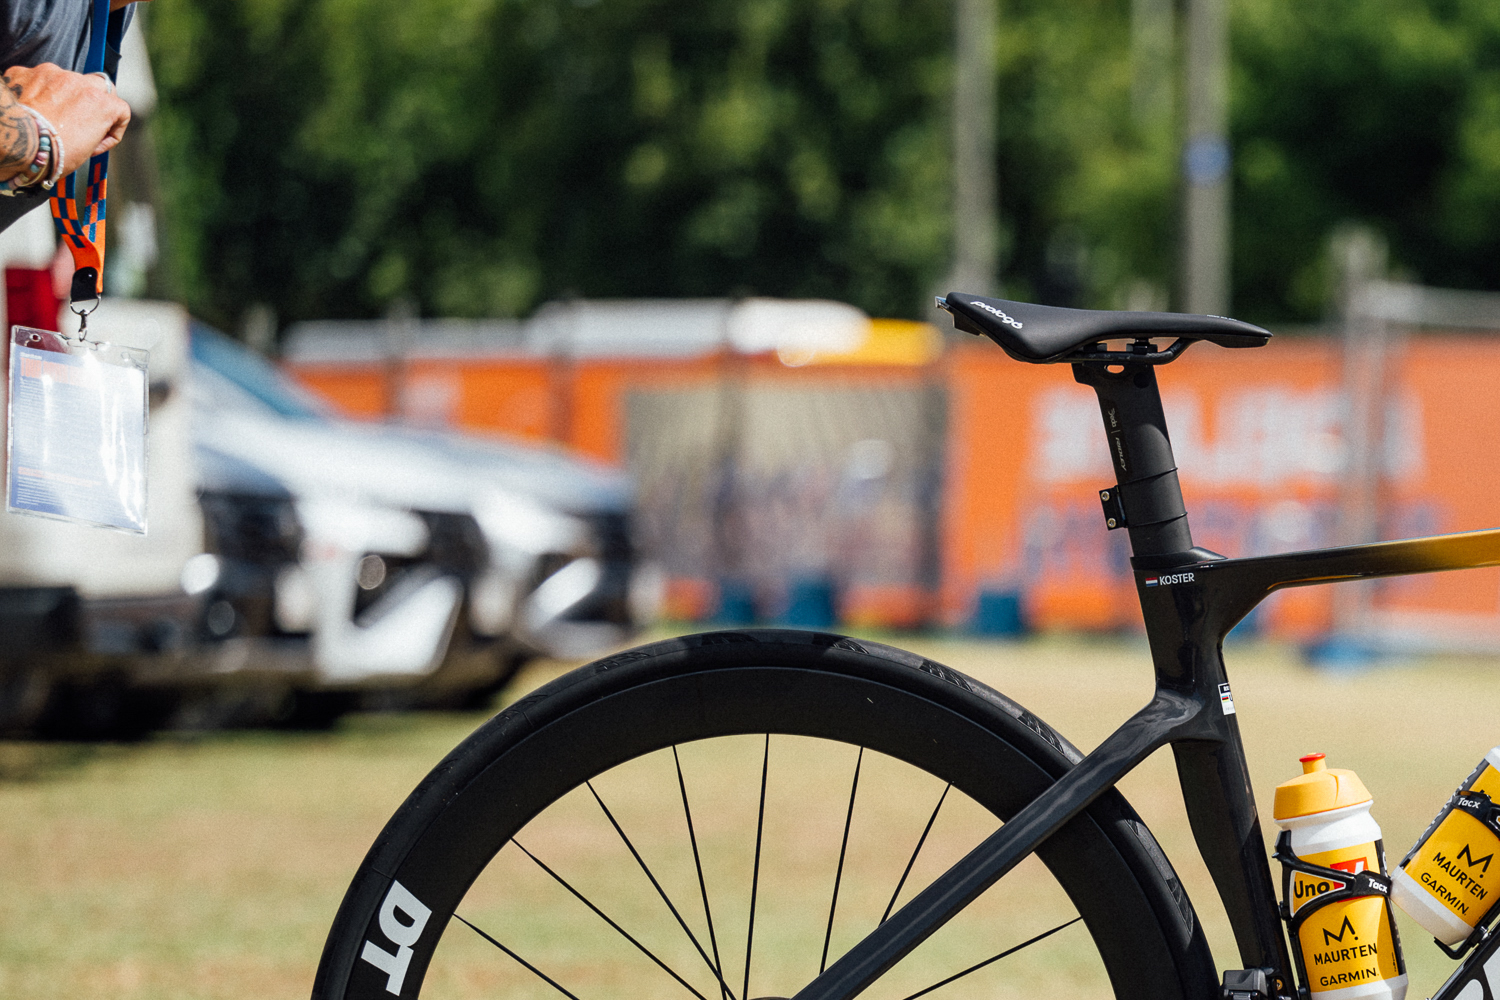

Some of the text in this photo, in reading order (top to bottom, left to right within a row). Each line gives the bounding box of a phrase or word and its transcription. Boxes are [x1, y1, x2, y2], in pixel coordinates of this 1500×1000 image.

[969, 300, 1023, 330] prologo
[1115, 436, 1127, 472] RIDLEY
[1159, 572, 1195, 586] KOSTER
[1457, 797, 1481, 809] Tacx
[1367, 877, 1388, 894] Tacx
[1432, 851, 1489, 901] MAURTEN
[1293, 879, 1331, 898] Uno
[361, 879, 434, 996] DT
[1313, 942, 1378, 966] MAURTEN
